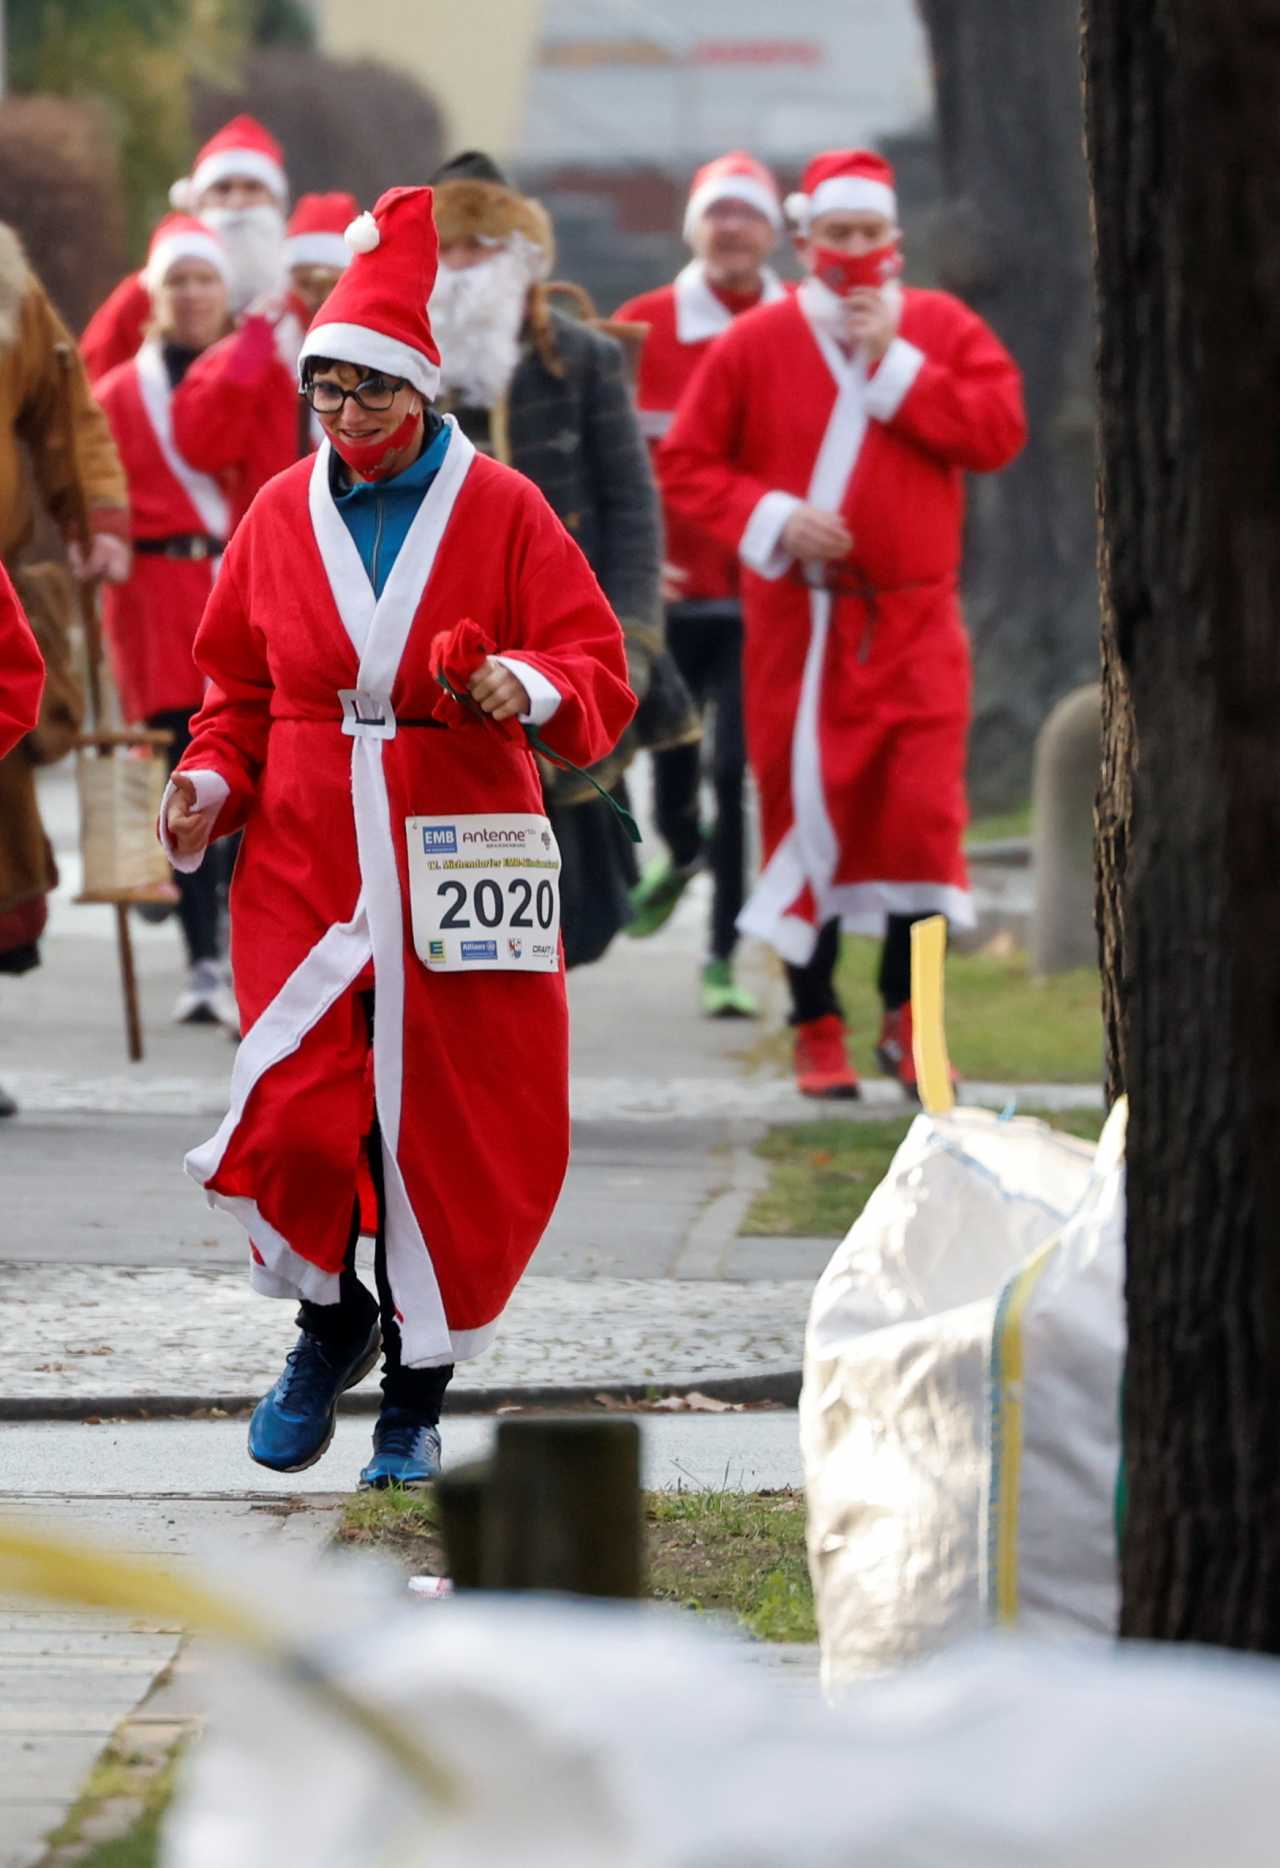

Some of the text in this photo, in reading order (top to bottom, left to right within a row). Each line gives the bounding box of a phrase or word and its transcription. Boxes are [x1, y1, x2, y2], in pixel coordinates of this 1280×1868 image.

[425, 831, 454, 844] EMB
[462, 828, 525, 843] Antenne
[436, 878, 554, 930] 2020
